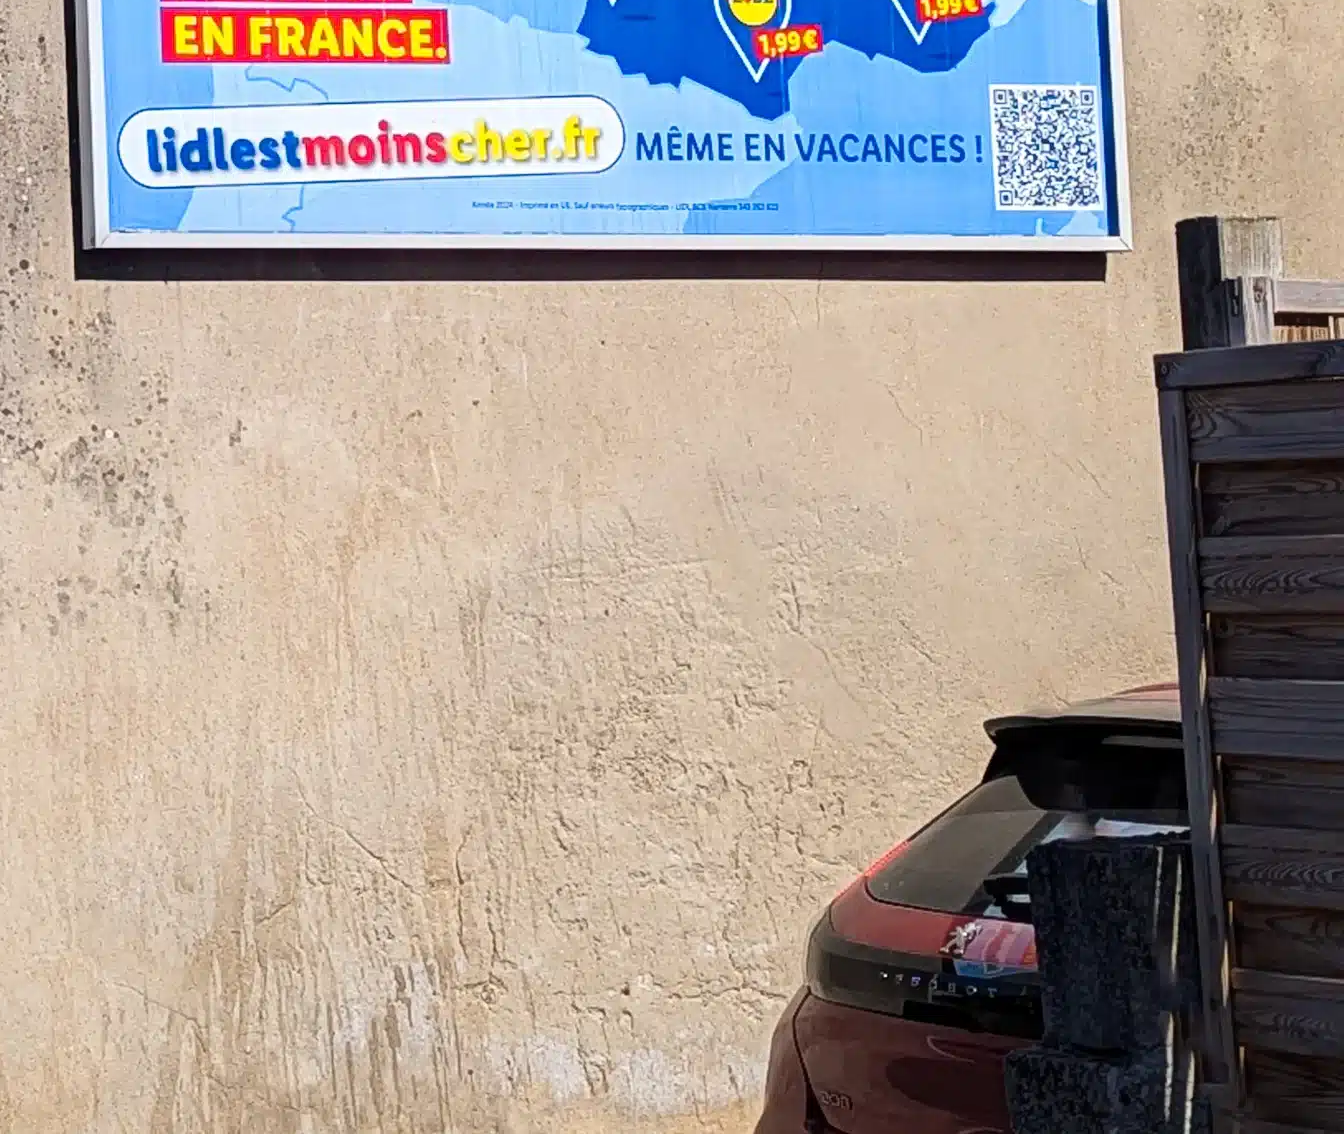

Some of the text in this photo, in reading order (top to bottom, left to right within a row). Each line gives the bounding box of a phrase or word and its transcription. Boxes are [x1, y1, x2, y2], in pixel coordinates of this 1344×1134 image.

[174, 15, 447, 59] EN FRANCE.
[146, 115, 600, 173] lidlestmoinscher.fr
[637, 126, 733, 162] MÊME
[745, 132, 785, 162] EN
[798, 132, 966, 163] VACANCES
